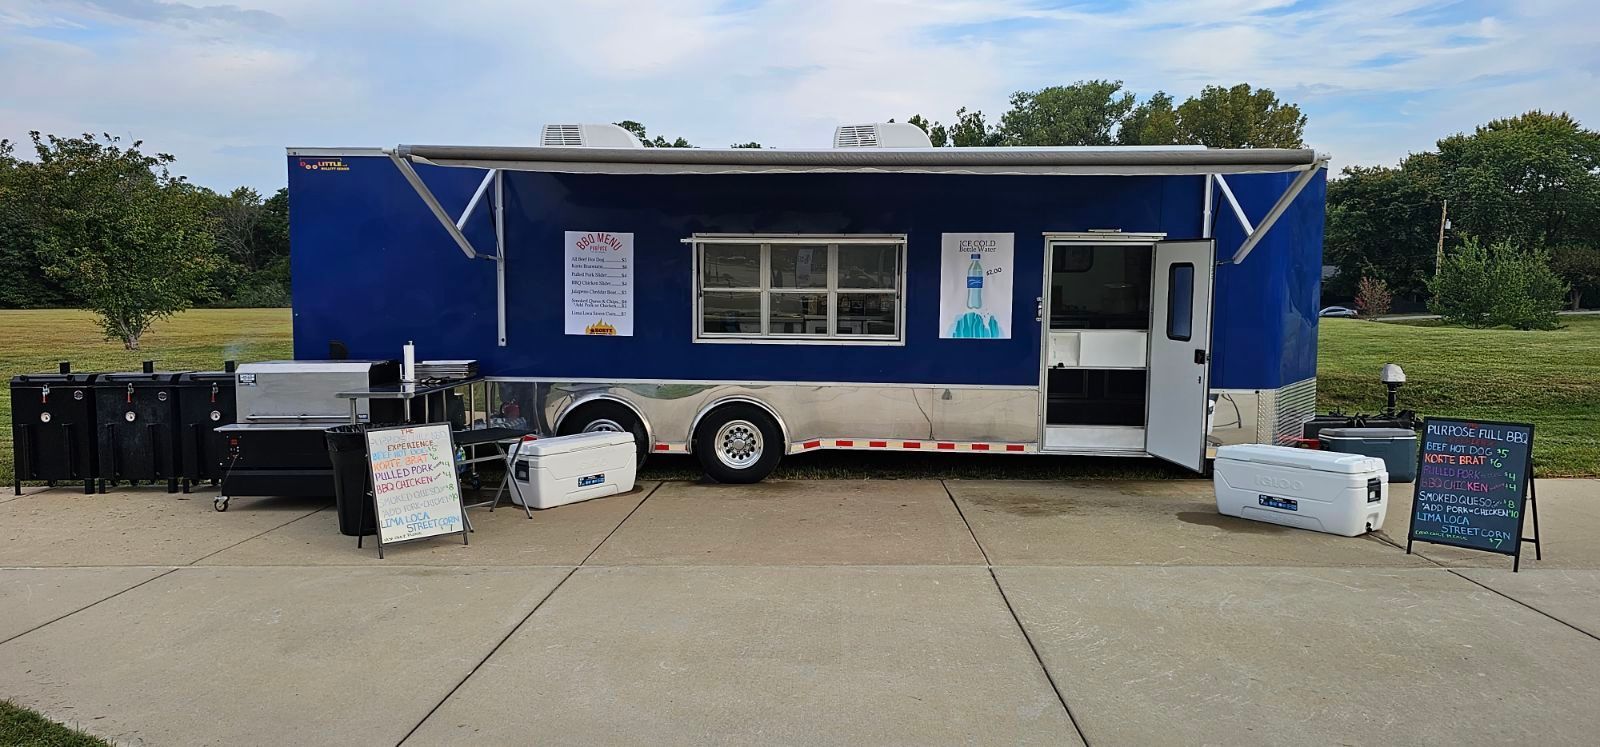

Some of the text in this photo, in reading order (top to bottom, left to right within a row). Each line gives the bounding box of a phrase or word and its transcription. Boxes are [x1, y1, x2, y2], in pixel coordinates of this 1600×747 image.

[576, 233, 623, 251] BBQ MENU
[986, 267, 1002, 276] $2.00
[1427, 424, 1475, 438] PURPOSE
[1478, 429, 1503, 441] FULL
[1506, 431, 1528, 445] BBQ
[387, 440, 434, 452] EXPERIENCE
[1426, 441, 1448, 452] BEEF
[1449, 444, 1467, 454] HOT
[1469, 446, 1492, 457] DOG
[1496, 448, 1509, 458] $5
[372, 450, 392, 460] BEEF
[393, 449, 407, 457] HOT
[373, 459, 401, 471] KORTE
[406, 454, 428, 463] BRAT
[1424, 453, 1502, 468] KORTE BRAT $6
[375, 468, 410, 481] PULLED
[411, 464, 434, 475] PORK
[1423, 465, 1516, 481] PULLED PORK $4
[376, 483, 394, 494] BBQ
[395, 476, 433, 489] CHICKEN
[1254, 474, 1304, 491] IGLOO
[1421, 477, 1517, 493] BBQ CHICKEN $4
[414, 486, 441, 498] QUESO
[1418, 490, 1515, 509] SMOKED QUESO $8
[1417, 511, 1470, 525] LIMA LOCA
[1446, 505, 1469, 514] PORK
[1474, 507, 1508, 517] CHICKEN
[380, 511, 430, 529] LIMA LOCA
[406, 515, 460, 533] STREET CORN
[1441, 525, 1511, 540] STREET CORN
[1489, 538, 1503, 549] $7
